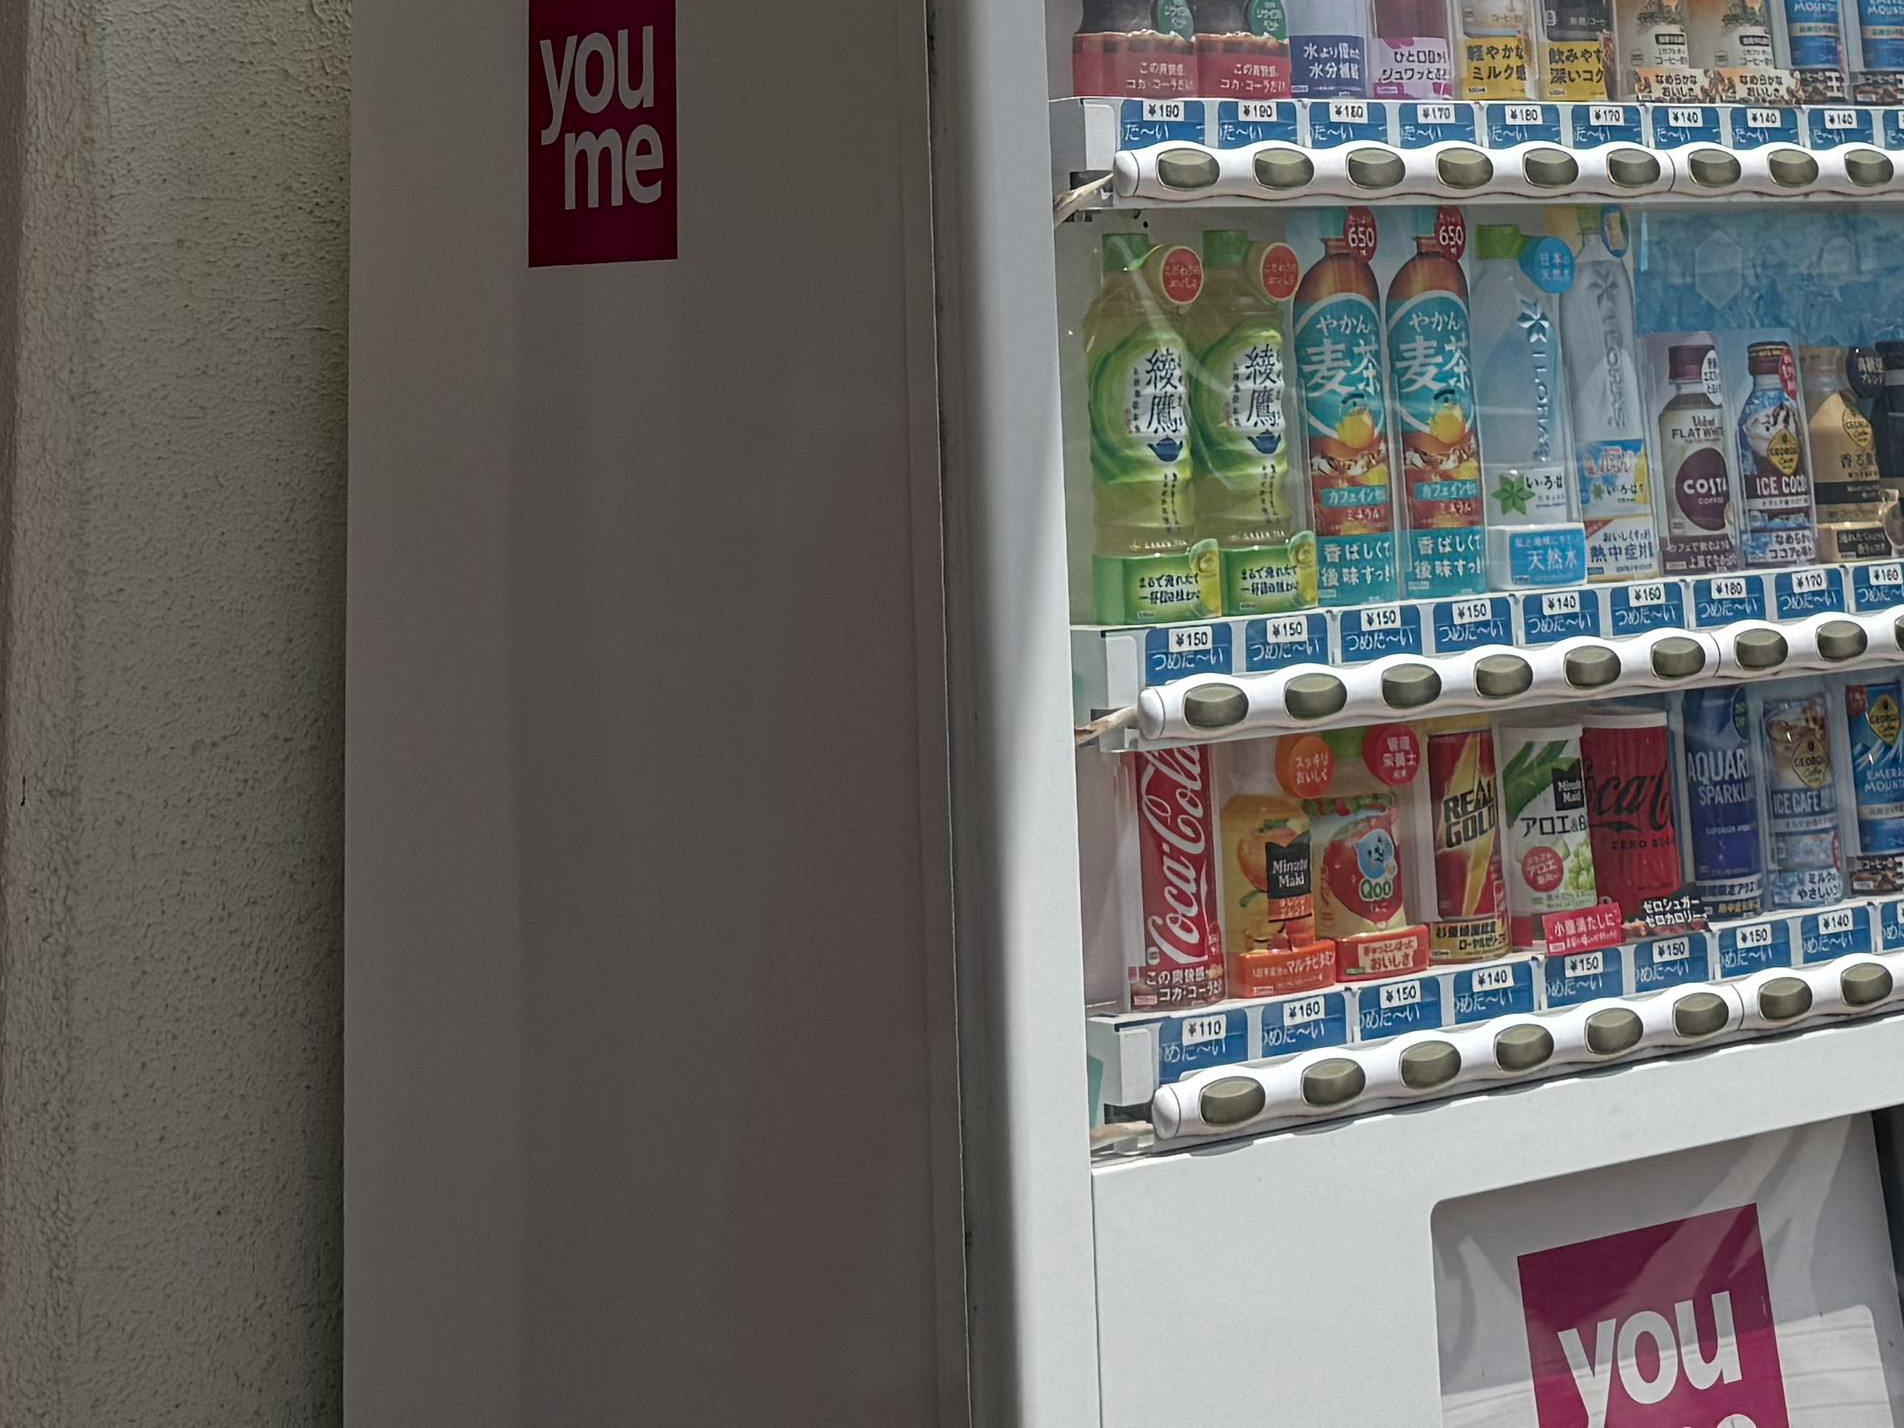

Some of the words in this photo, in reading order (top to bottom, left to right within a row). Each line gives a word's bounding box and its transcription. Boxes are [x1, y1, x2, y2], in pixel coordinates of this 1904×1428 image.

[539, 25, 655, 146] you
[1422, 106, 1451, 121] ¥170
[1671, 111, 1699, 125] ¥140
[1750, 112, 1778, 126] ¥140
[564, 124, 664, 210] me
[1347, 225, 1375, 247] 650
[1438, 225, 1464, 246] 650
[1316, 314, 1370, 333] やかん
[1408, 313, 1459, 332] やかん
[1300, 338, 1382, 398] 麦茶
[1395, 335, 1470, 394] 麦茶
[1146, 347, 1178, 434] 綾鷹
[1245, 343, 1277, 429] 綾鷹
[1756, 477, 1778, 496] ICE
[1528, 549, 1578, 571] 天然水
[1547, 593, 1577, 610] ¥140
[1365, 610, 1398, 626] ¥150
[1457, 603, 1488, 619] ¥150
[1271, 620, 1303, 638] ¥150
[1175, 630, 1209, 648] ¥150
[1443, 782, 1494, 826] REAL
[1278, 873, 1305, 888] Maid
[1359, 878, 1393, 901] Qoo
[1822, 913, 1850, 930] ¥140
[1741, 929, 1768, 945] ¥150
[1657, 941, 1686, 958] ¥150
[1569, 955, 1600, 972] ¥150
[1477, 970, 1508, 988] ¥140
[1385, 985, 1417, 1003] ¥150
[1188, 1019, 1222, 1037] ¥110
[1557, 1290, 1743, 1428] you
